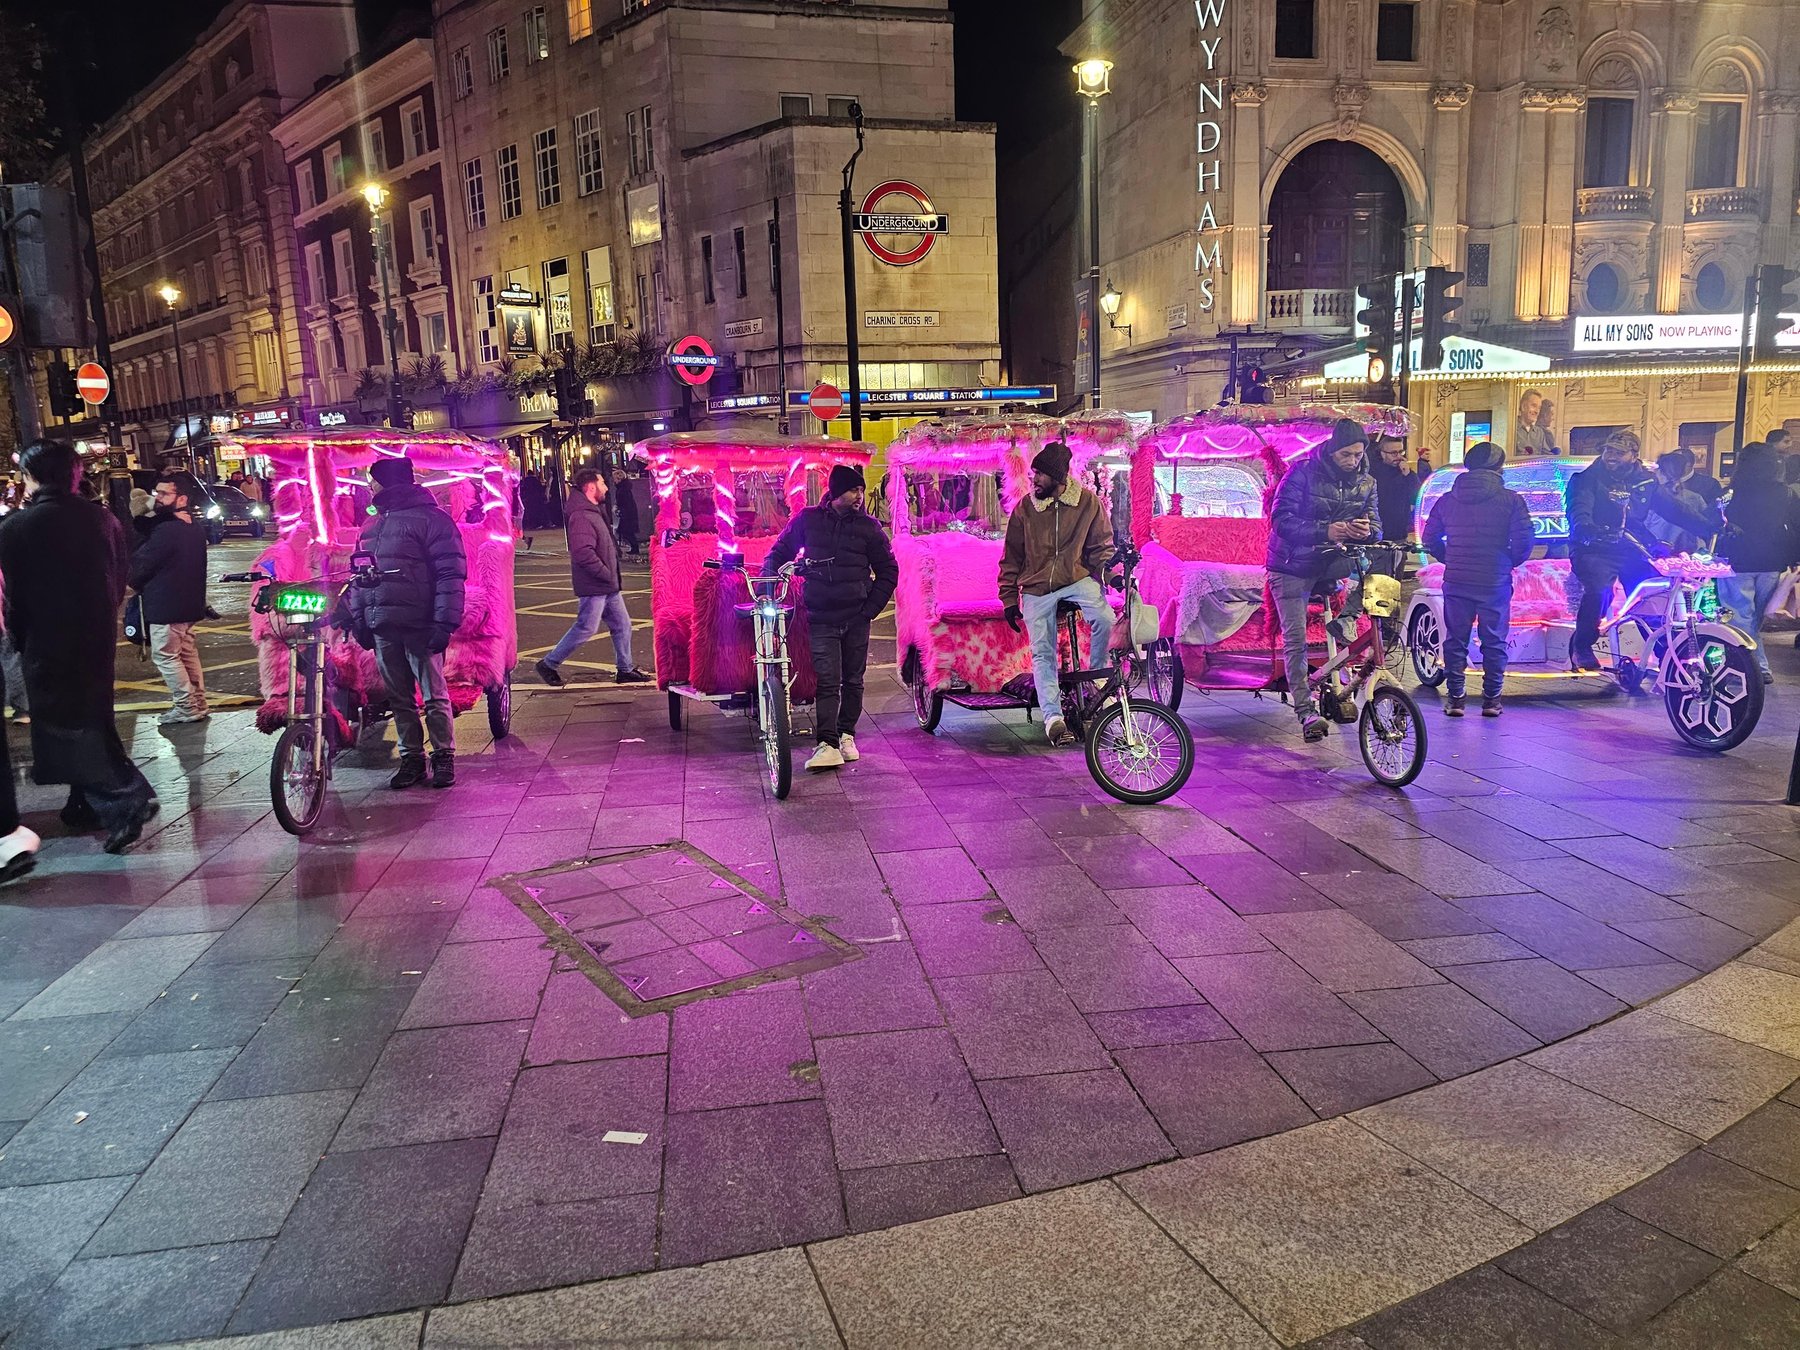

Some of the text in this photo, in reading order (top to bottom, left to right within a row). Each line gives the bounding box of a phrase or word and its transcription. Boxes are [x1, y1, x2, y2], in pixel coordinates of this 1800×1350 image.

[1195, 0, 1225, 309] WYNDHAMS
[867, 317, 896, 325] CHARING
[900, 317, 921, 325] CROSS
[1584, 324, 1602, 341] ALL
[1606, 324, 1623, 341] MY
[1626, 323, 1654, 341] SONS
[1659, 326, 1686, 337] NOW
[1688, 325, 1732, 337] PLAYING
[672, 356, 717, 365] UNDERGROUND
[1449, 348, 1484, 370] SONS
[710, 400, 735, 409] LEICESTER
[736, 397, 758, 406] SQUARE
[868, 391, 983, 401] LEICESTER SQUARE STATION
[283, 595, 325, 611] TAXI
